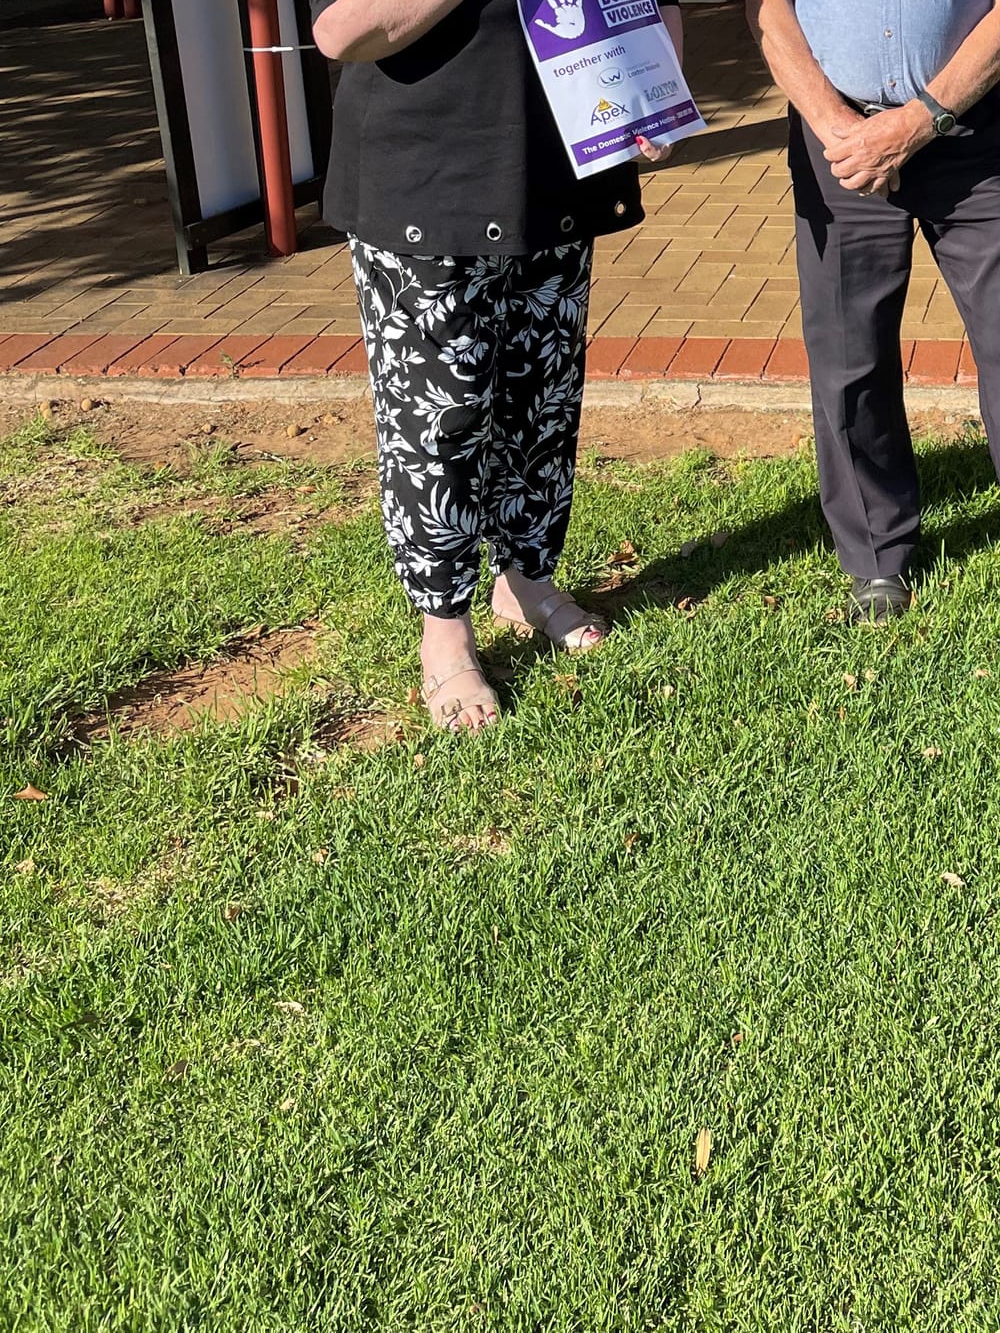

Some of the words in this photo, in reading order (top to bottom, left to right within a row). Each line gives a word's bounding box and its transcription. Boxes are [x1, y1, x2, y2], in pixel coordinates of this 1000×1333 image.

[606, 0, 653, 24] VIOLENCE
[554, 53, 603, 78] together
[604, 45, 626, 61] with
[644, 80, 679, 102] LOXTON
[591, 104, 631, 126] Apex
[582, 144, 598, 155] The
